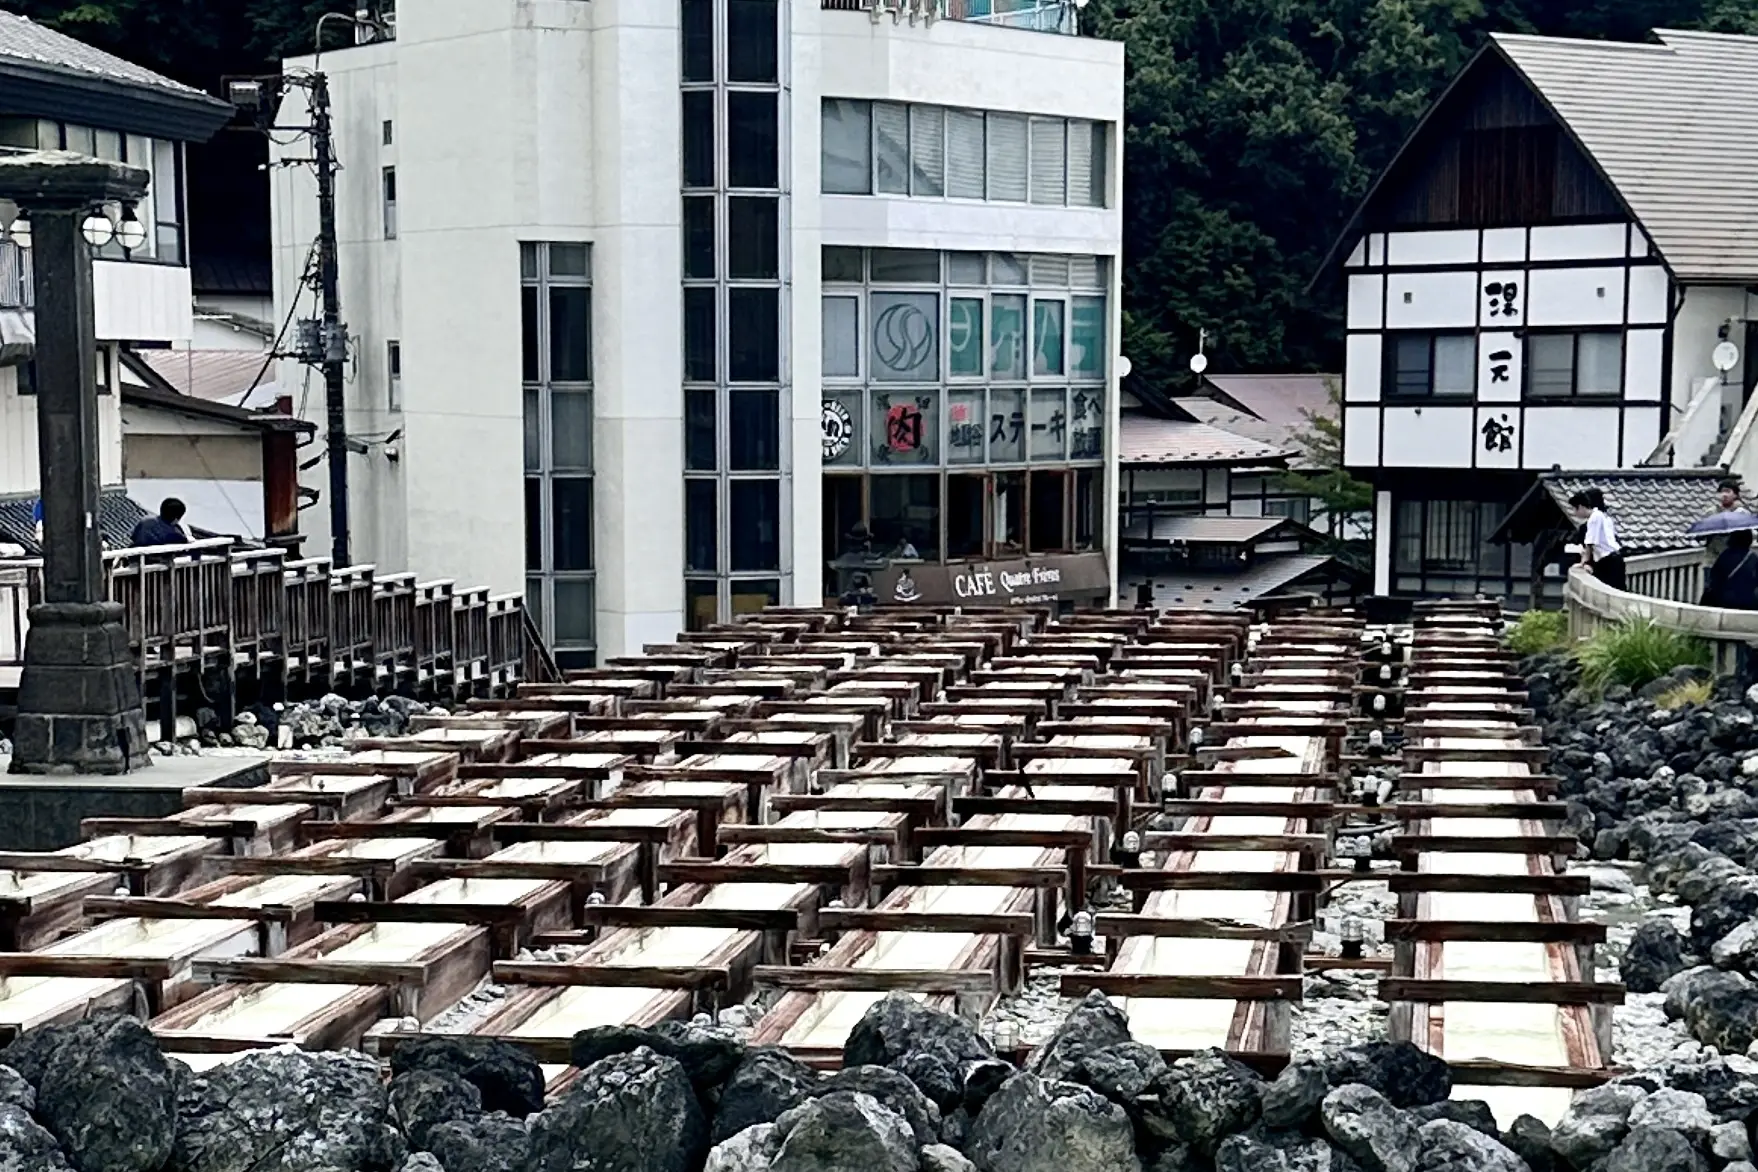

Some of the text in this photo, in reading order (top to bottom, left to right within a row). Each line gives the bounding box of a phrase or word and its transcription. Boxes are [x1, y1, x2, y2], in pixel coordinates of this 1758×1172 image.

[887, 407, 922, 449] 肉
[991, 408, 1067, 444] ステーキ
